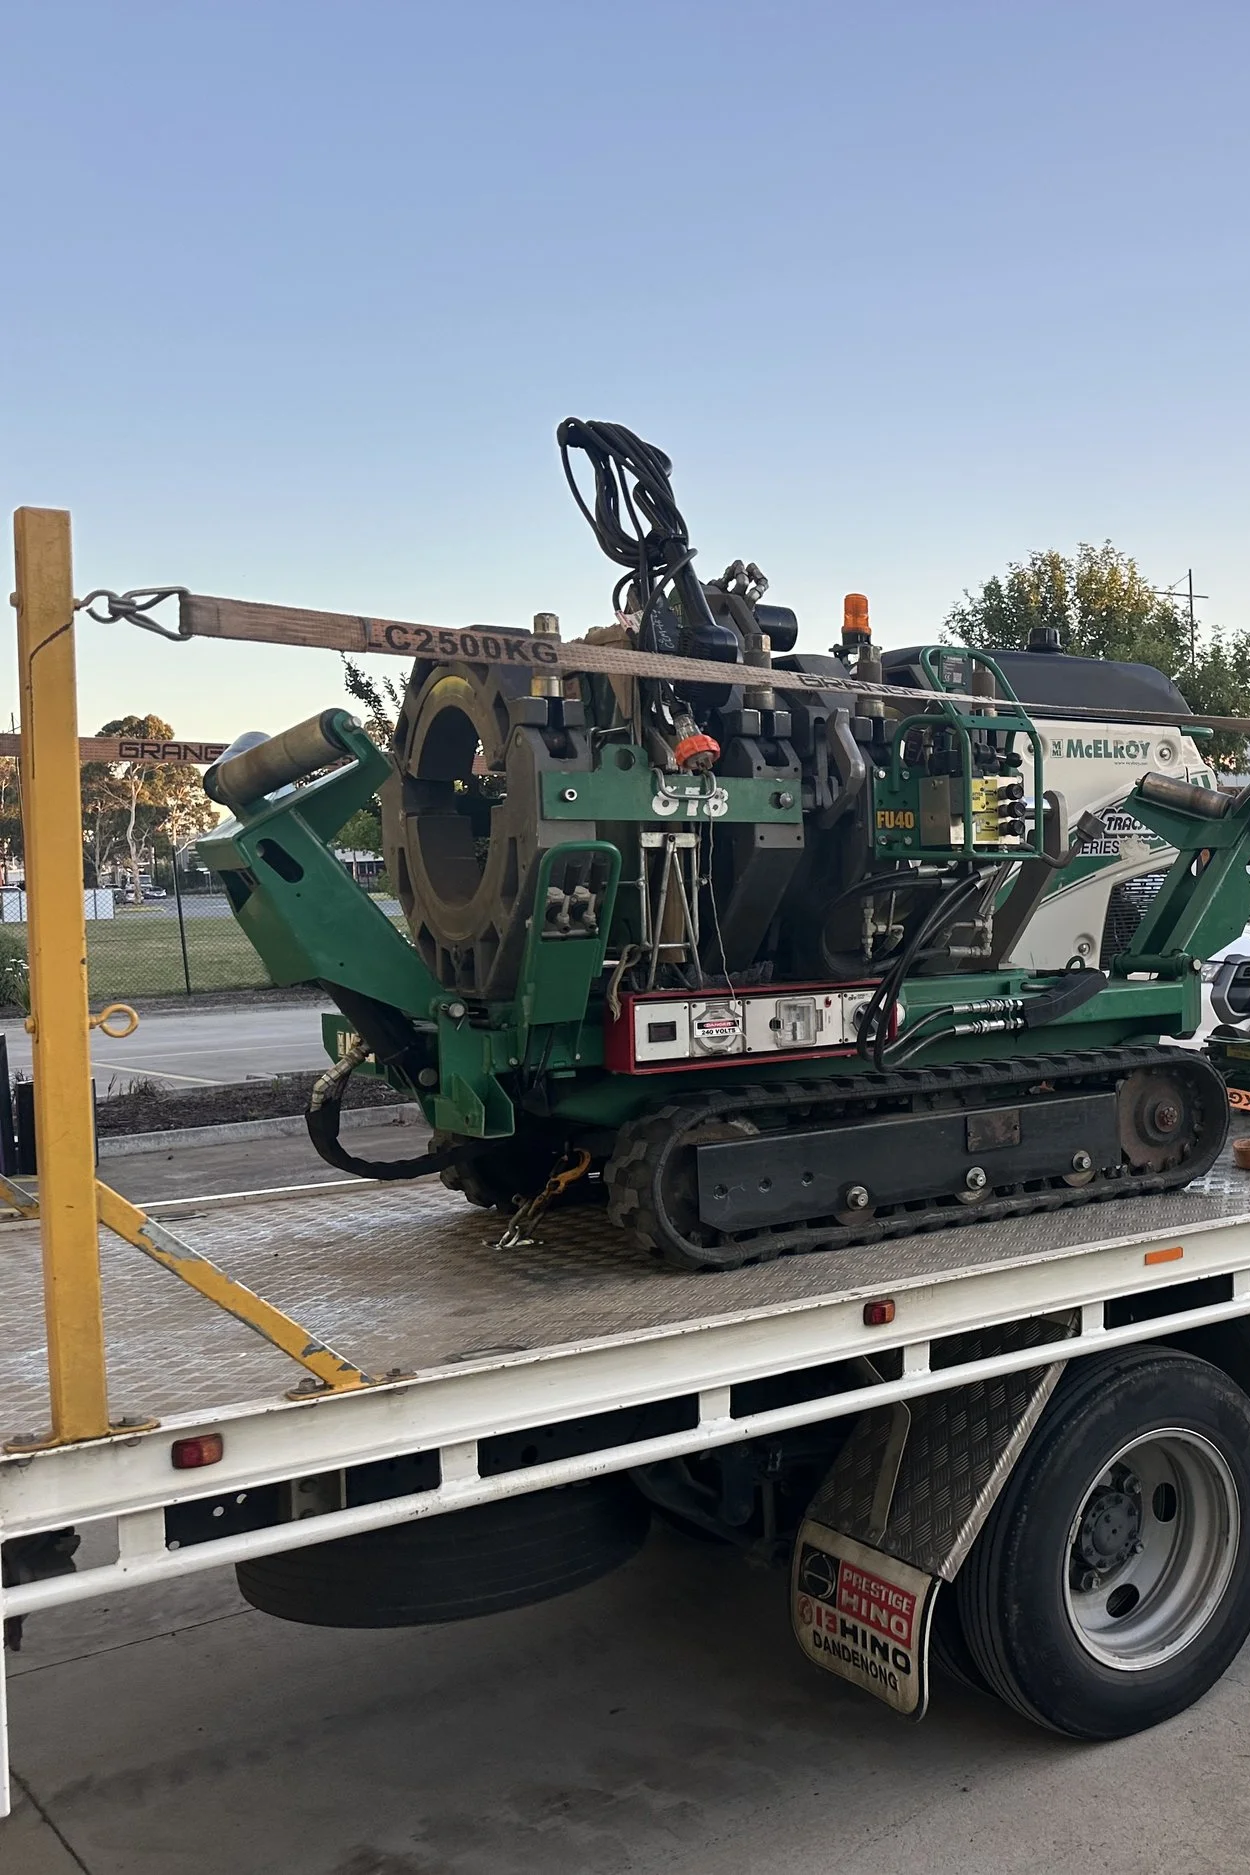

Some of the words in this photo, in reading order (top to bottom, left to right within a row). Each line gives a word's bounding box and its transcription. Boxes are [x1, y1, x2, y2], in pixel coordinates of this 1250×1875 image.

[368, 624, 560, 664] C2500KG
[118, 741, 229, 762] GRANG
[1066, 739, 1151, 759] McELROY
[876, 810, 915, 829] FU40
[1081, 840, 1120, 855] ERIES
[843, 1567, 912, 1616] PRESTIGE
[841, 1588, 910, 1642] HINO
[813, 1628, 900, 1693] DANDENONG
